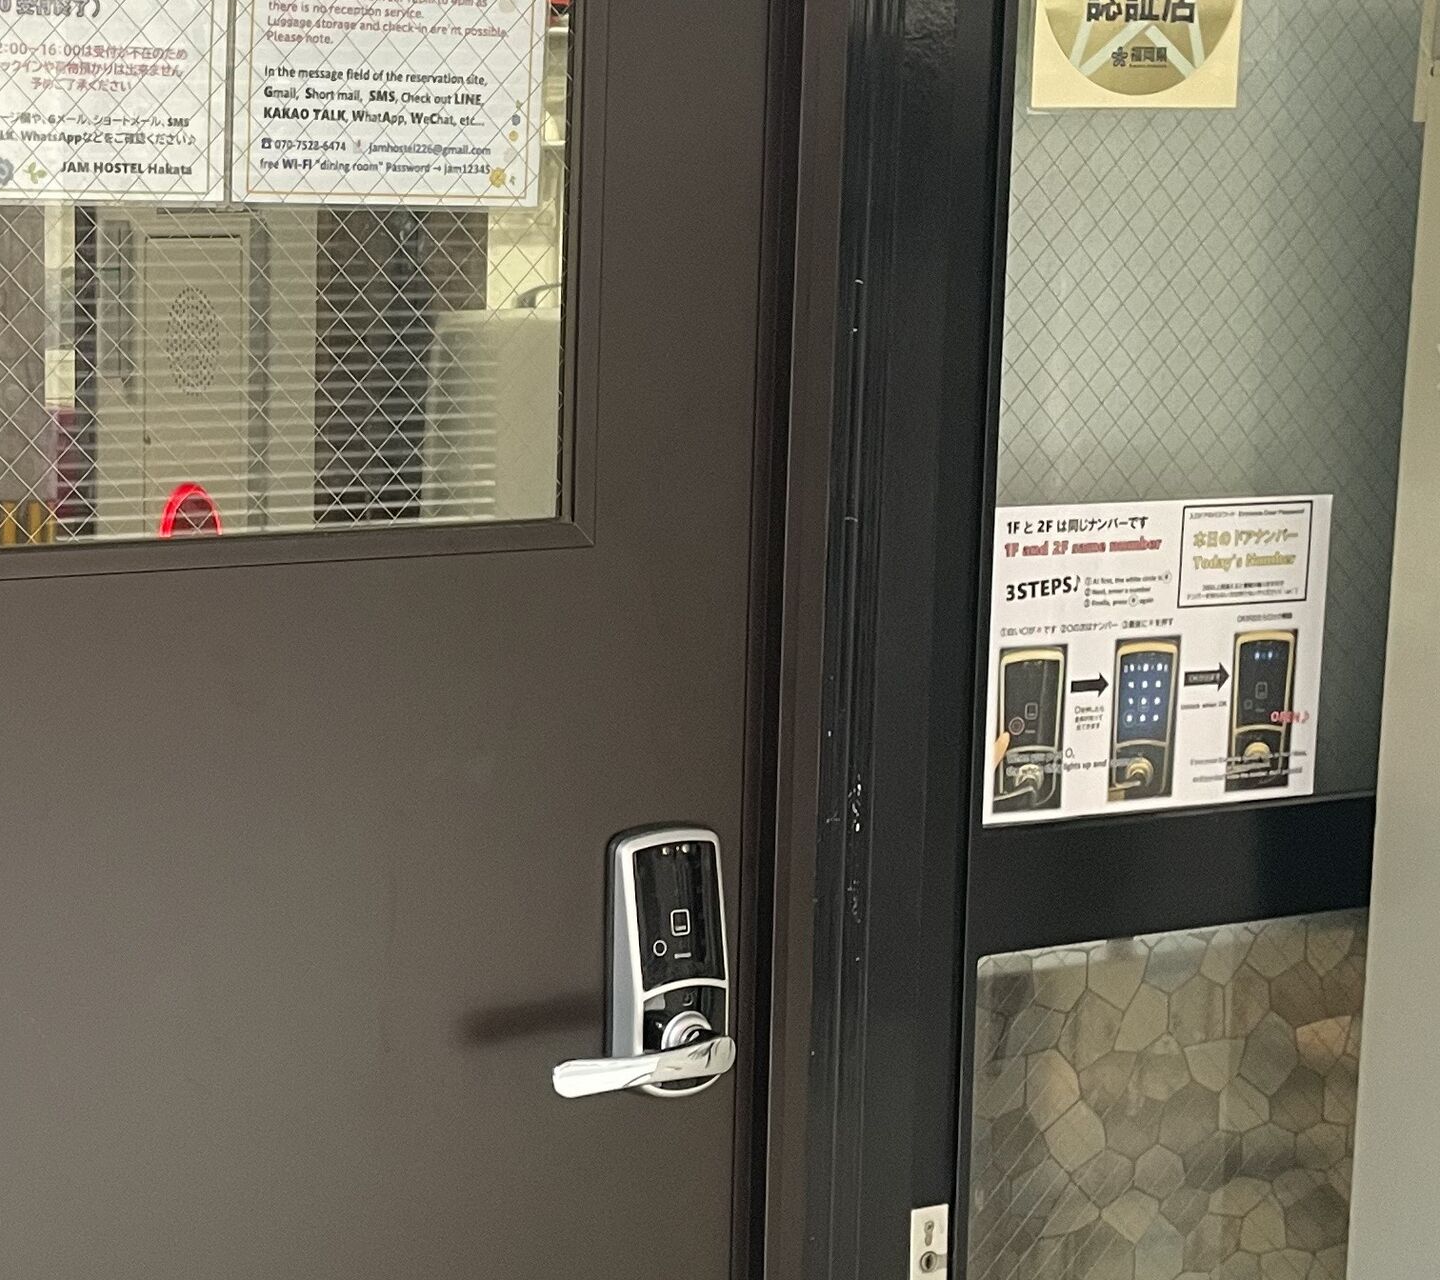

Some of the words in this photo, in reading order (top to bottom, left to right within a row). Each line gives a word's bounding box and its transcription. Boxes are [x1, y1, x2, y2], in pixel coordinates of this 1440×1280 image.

[269, 1, 297, 13] there
[328, 5, 382, 19] reception
[267, 16, 312, 30] Luggage
[315, 18, 357, 32] storage
[266, 31, 302, 44] Please
[264, 65, 275, 77] In
[277, 66, 296, 78] the
[298, 68, 344, 81] message
[346, 68, 370, 81] field
[373, 69, 384, 81] of
[386, 71, 403, 82] the
[406, 72, 464, 85] reservation
[305, 87, 334, 100] Short
[401, 92, 431, 104] Check
[434, 94, 452, 105] out
[263, 107, 310, 120] KAKAO
[60, 161, 90, 174] JAM
[93, 162, 145, 175] HOSTEL
[148, 164, 193, 176] Hakata
[260, 158, 279, 170] free
[386, 161, 431, 174] Password
[1004, 541, 1019, 558] 1F
[1022, 540, 1049, 556] and
[1052, 539, 1069, 555] 2F
